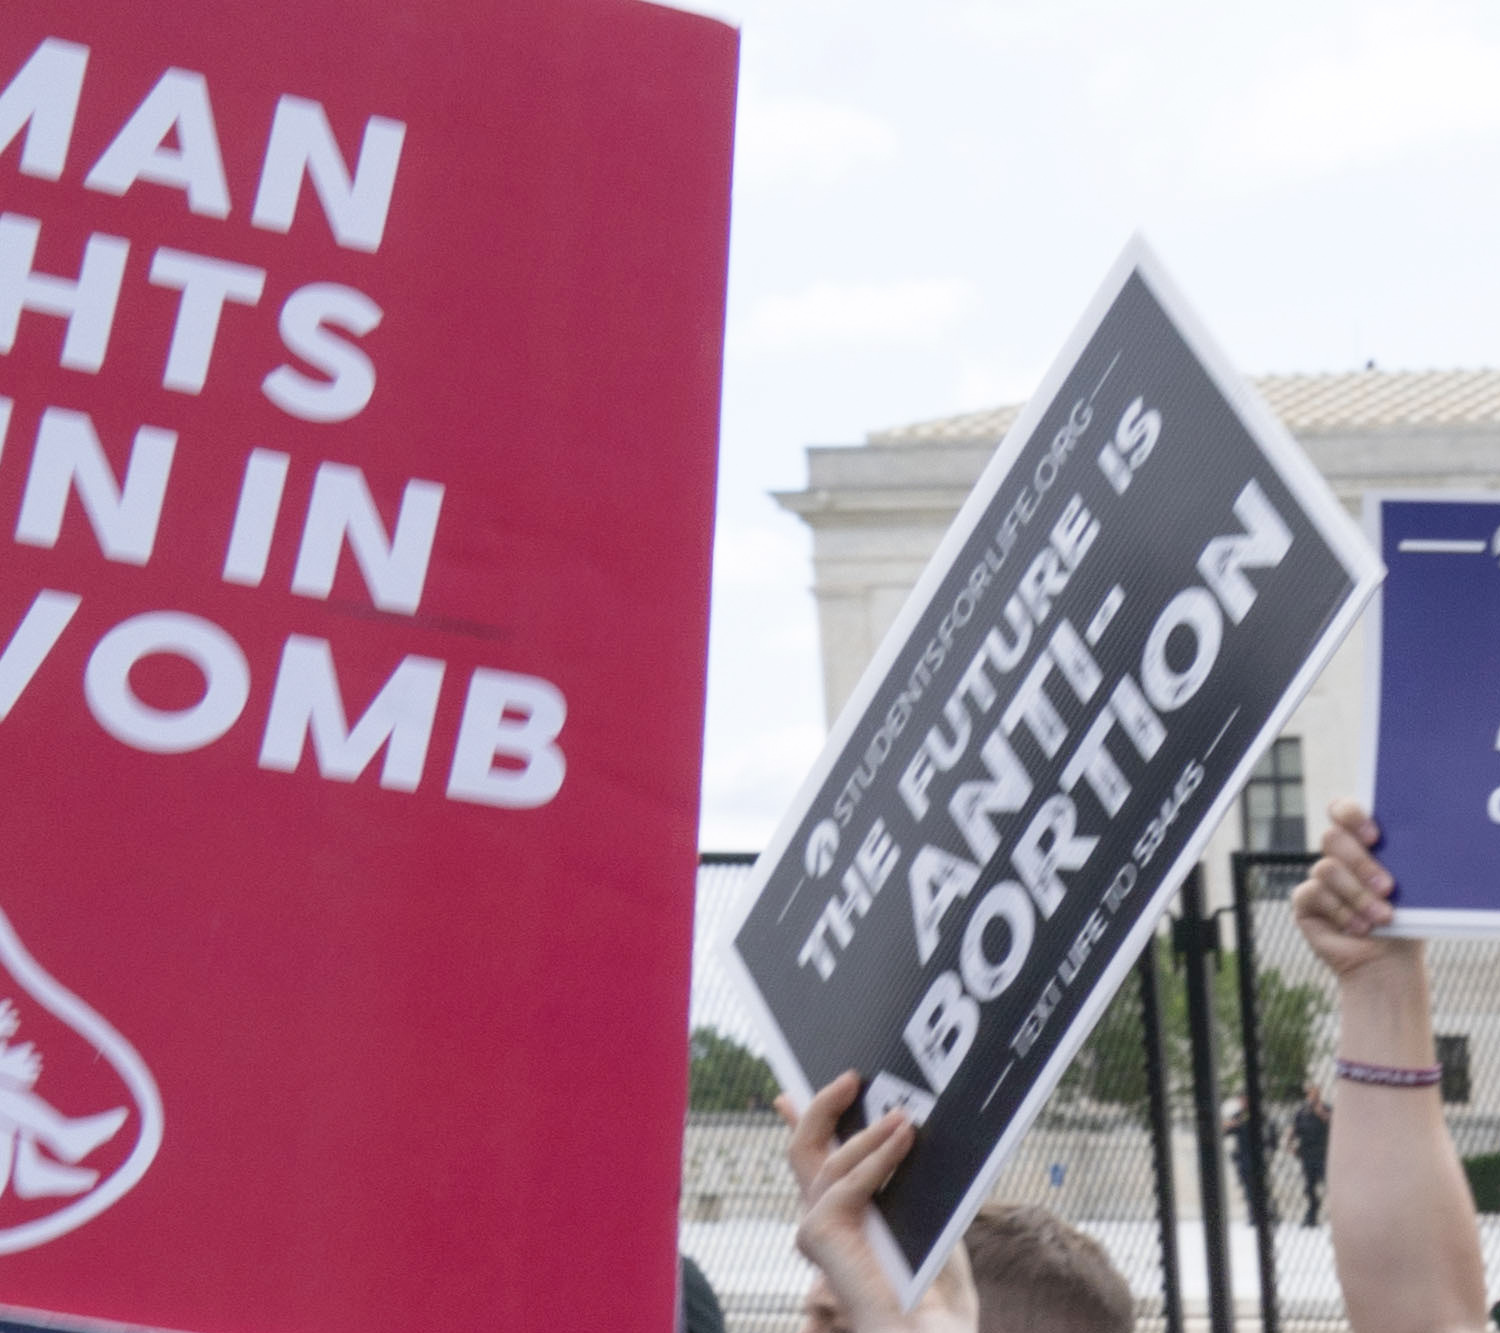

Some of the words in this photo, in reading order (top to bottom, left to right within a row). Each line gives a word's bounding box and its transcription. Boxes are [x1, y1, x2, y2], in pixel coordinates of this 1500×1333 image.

[222, 447, 446, 616] IN
[797, 817, 902, 983] THE
[897, 494, 1103, 824] FUTURE
[1096, 395, 1162, 496] IS
[834, 398, 1094, 827] STUDENTSFORLIFE.ORG
[907, 584, 1126, 965] ANTI-
